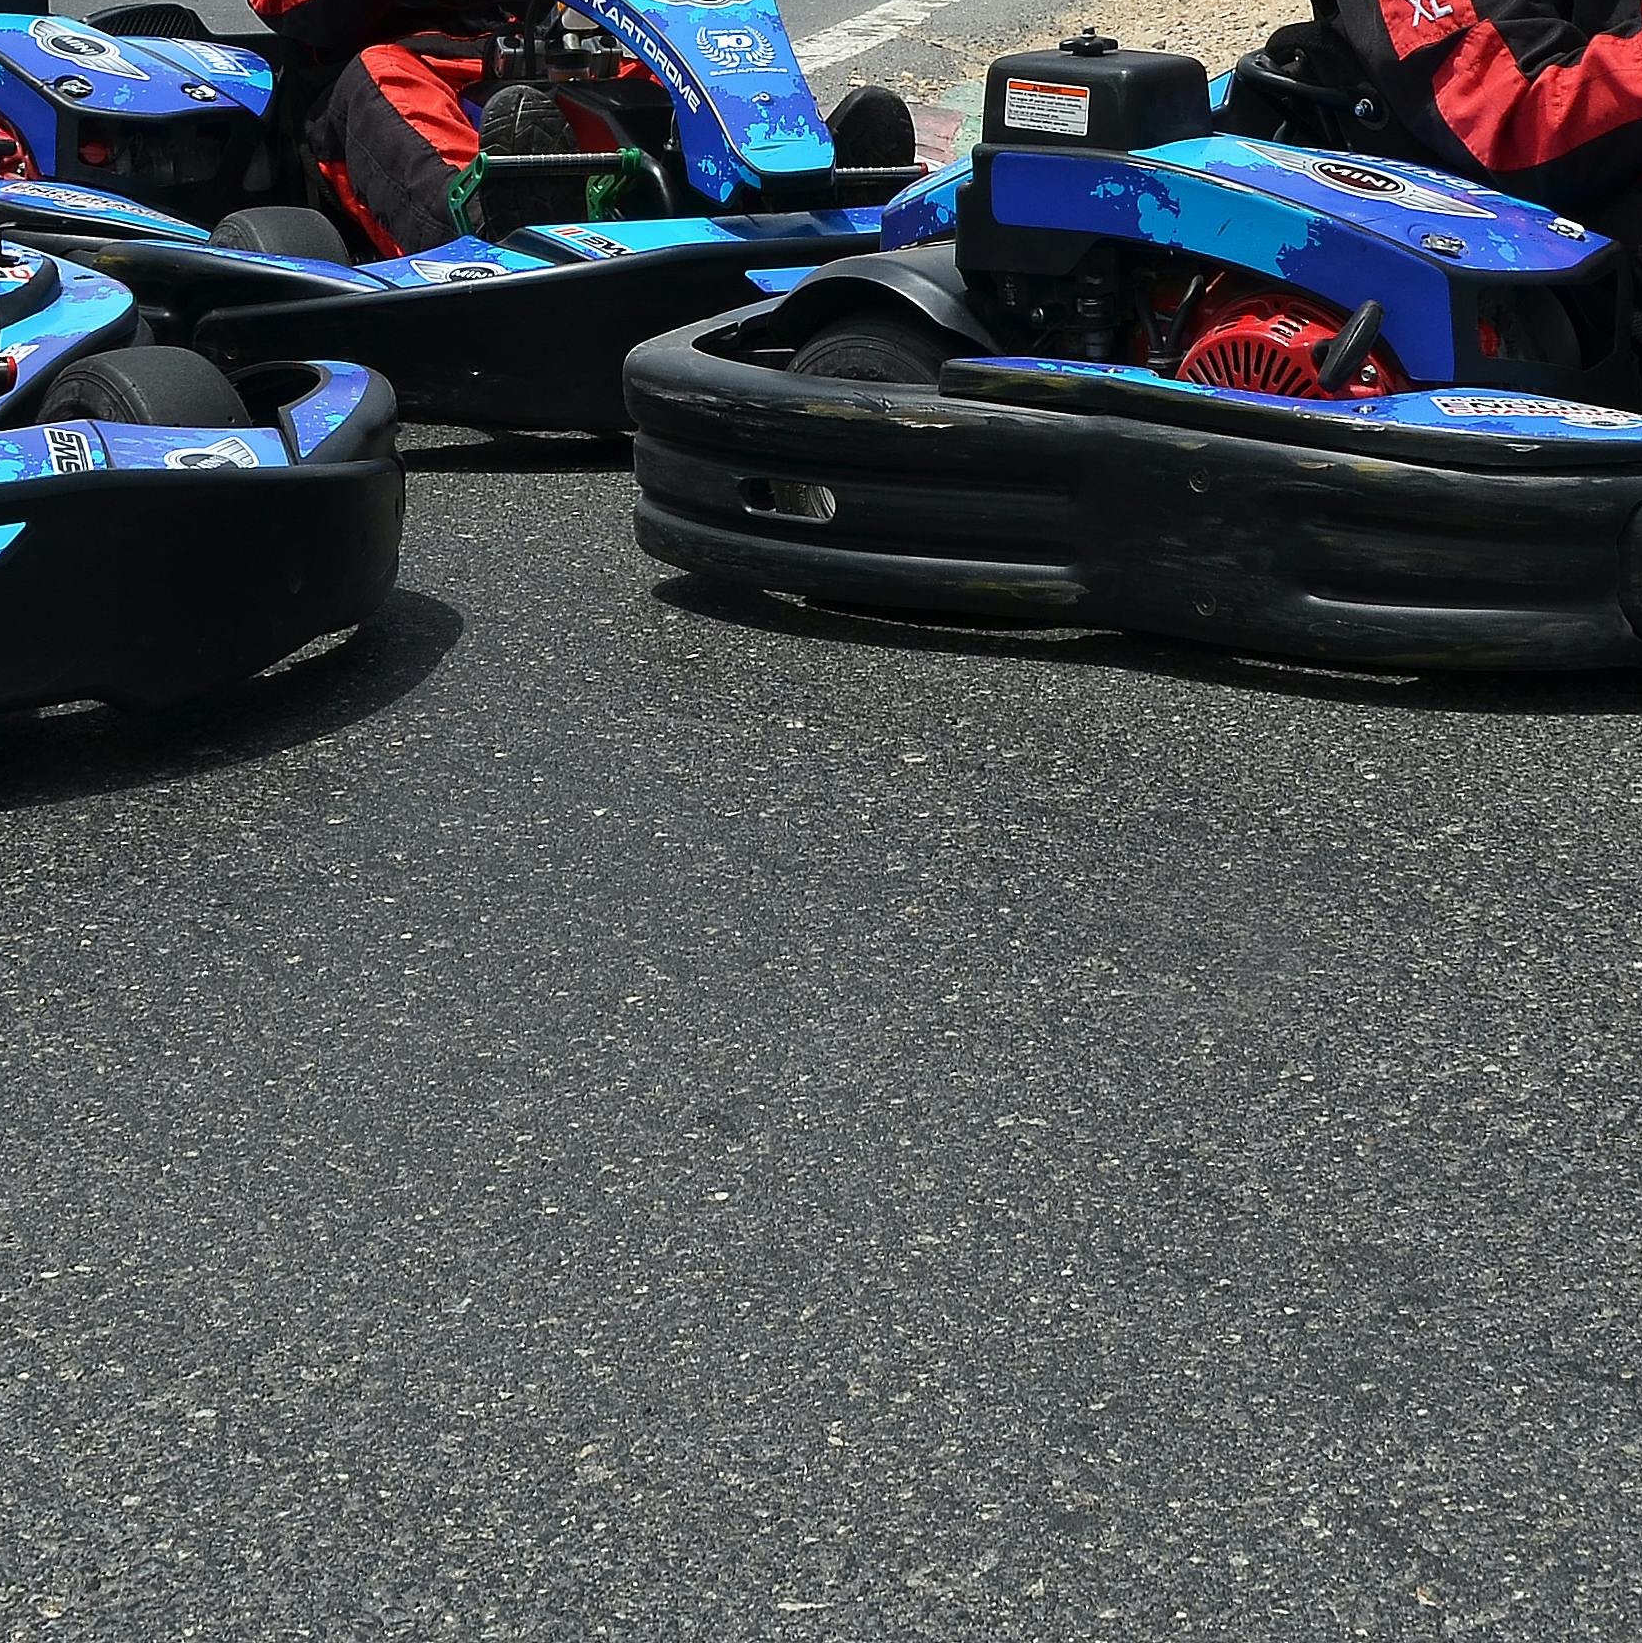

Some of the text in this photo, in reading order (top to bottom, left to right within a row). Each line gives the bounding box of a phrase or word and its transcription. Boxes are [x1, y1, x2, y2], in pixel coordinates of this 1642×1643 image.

[58, 32, 99, 55] MINI
[713, 35, 753, 48] 10
[1322, 163, 1397, 190] MINI
[577, 236, 637, 258] SW
